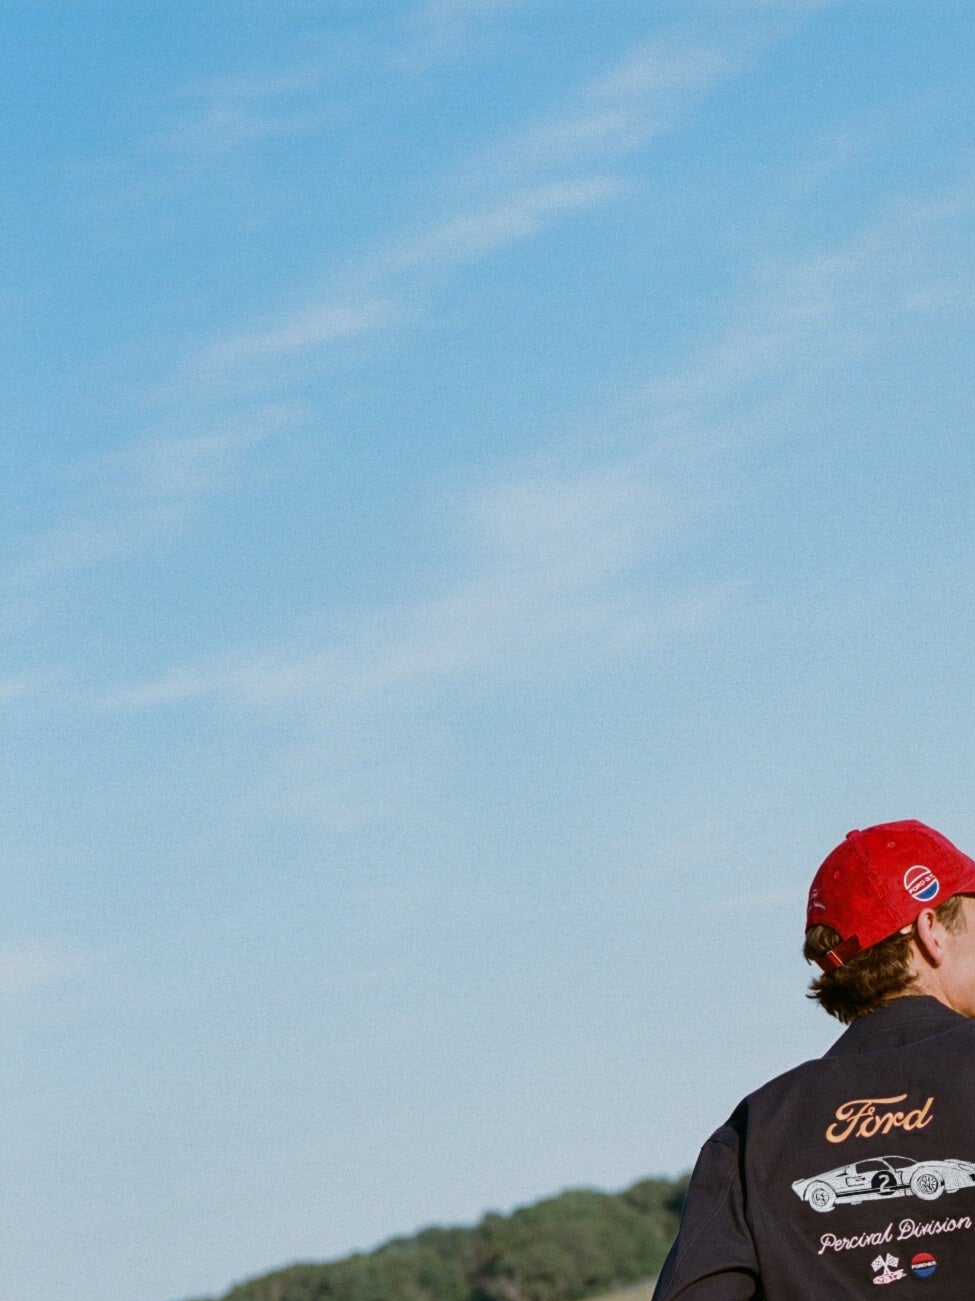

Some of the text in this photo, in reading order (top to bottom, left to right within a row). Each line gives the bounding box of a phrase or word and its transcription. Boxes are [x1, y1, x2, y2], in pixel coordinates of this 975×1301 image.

[825, 1093, 935, 1143] Ford
[878, 1174, 896, 1193] 2
[818, 1216, 972, 1255] Percival Division
